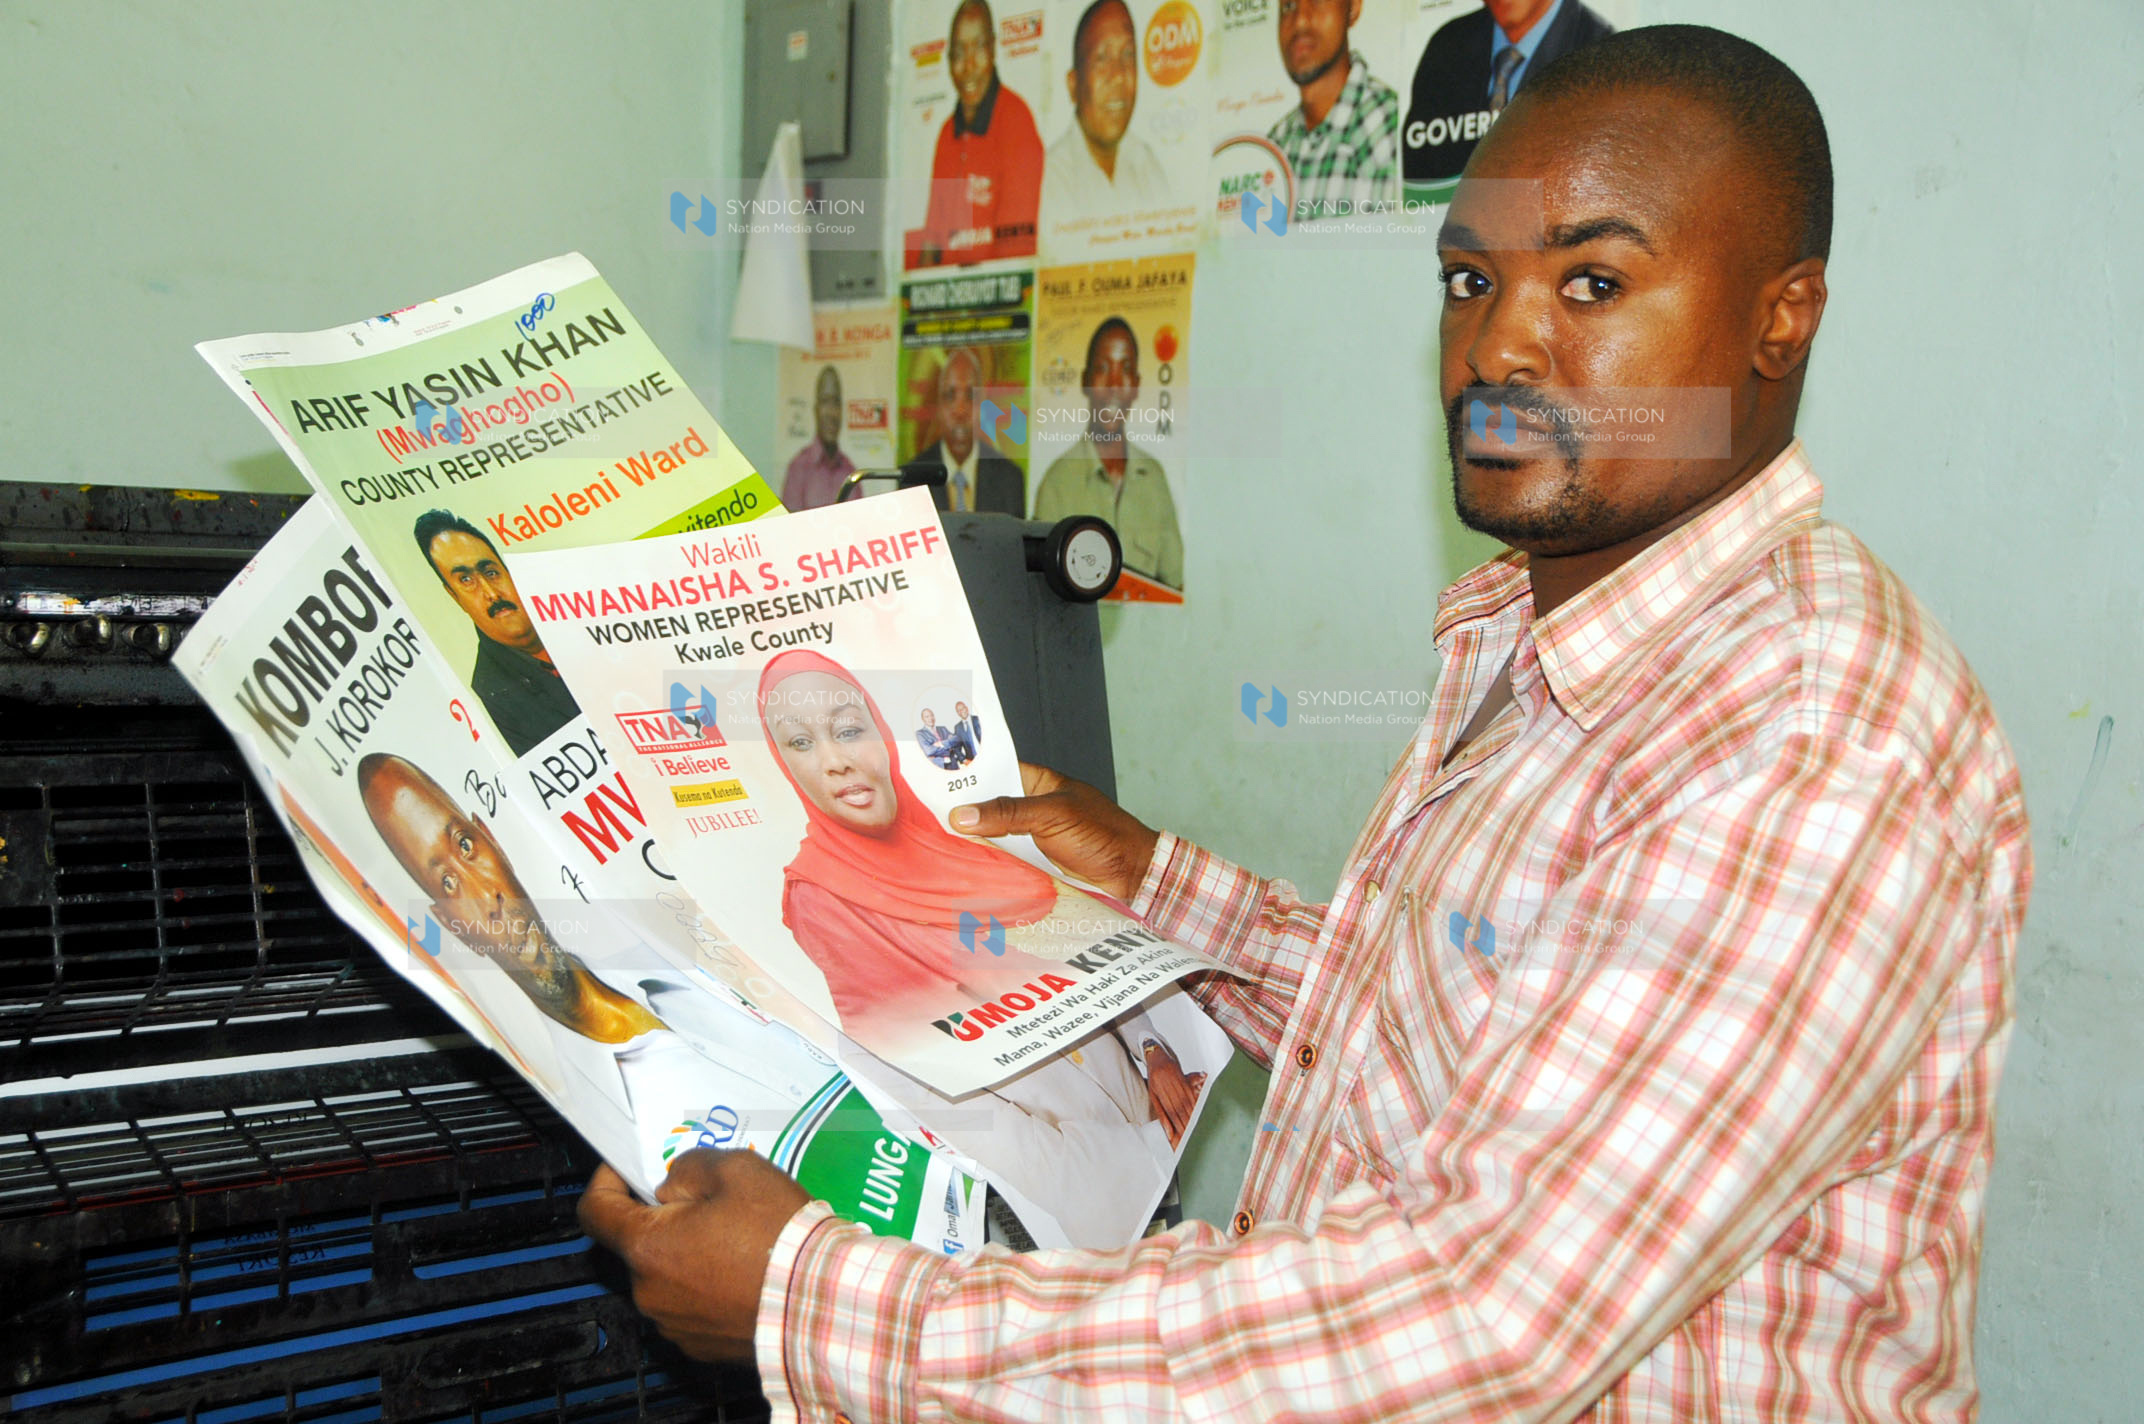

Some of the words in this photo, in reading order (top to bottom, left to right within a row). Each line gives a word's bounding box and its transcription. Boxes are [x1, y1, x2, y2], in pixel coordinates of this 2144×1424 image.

[1148, 11, 1199, 52] ODM
[291, 393, 370, 434] ARIF
[371, 357, 503, 420] YASIN
[500, 307, 627, 379] KHAN
[340, 464, 440, 506] COUNTY
[438, 371, 674, 485] REPRESENTATIVE
[376, 371, 576, 465] (Mwaghogho)
[487, 470, 621, 547] Kaloleni
[615, 426, 710, 488] Ward
[530, 568, 753, 622] MWANAISHA
[758, 561, 790, 591] S.
[797, 525, 940, 583] SHARIFF
[680, 532, 763, 569] Wakili
[585, 613, 692, 646] WOMEN
[694, 568, 910, 633] REPRESENTATIVE
[674, 635, 745, 664] Kwale
[751, 621, 834, 652] County
[623, 715, 692, 743] TNA
[662, 754, 731, 776] Believe
[947, 774, 978, 792] 2013
[686, 808, 763, 839] JUBILEE!
[930, 973, 1077, 1042] UMOJA
[993, 1039, 1048, 1067] Mama,
[1042, 1010, 1099, 1041] Wazee,
[1093, 984, 1139, 1011] Vijana
[1138, 971, 1160, 986] Na
[1006, 1005, 1063, 1038] Mtetezi
[1060, 993, 1088, 1009] Wa
[1085, 972, 1119, 997] Haki
[1115, 962, 1139, 977] Za
[1138, 946, 1174, 966] Akina
[859, 1136, 912, 1221] LUNG
